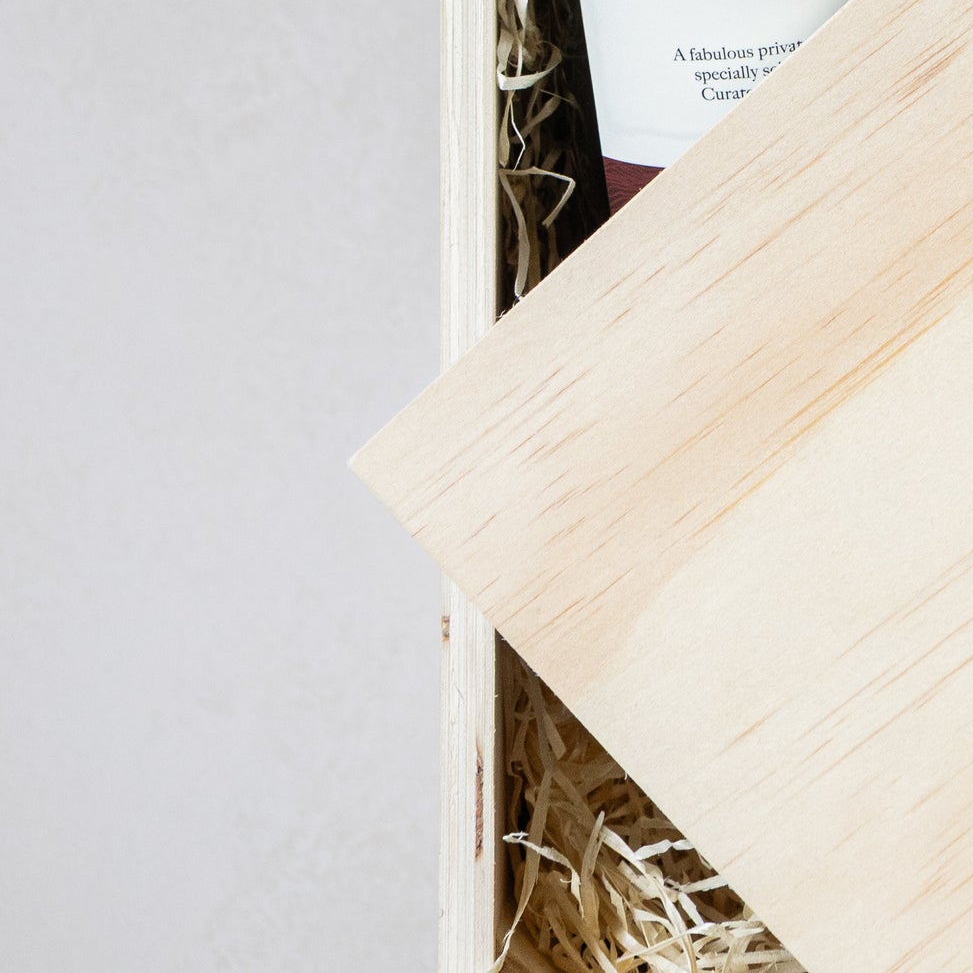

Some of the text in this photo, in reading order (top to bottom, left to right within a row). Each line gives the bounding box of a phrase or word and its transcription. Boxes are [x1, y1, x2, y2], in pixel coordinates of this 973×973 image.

[673, 47, 686, 62] A
[689, 45, 755, 62] fabulous
[694, 64, 759, 85] specially
